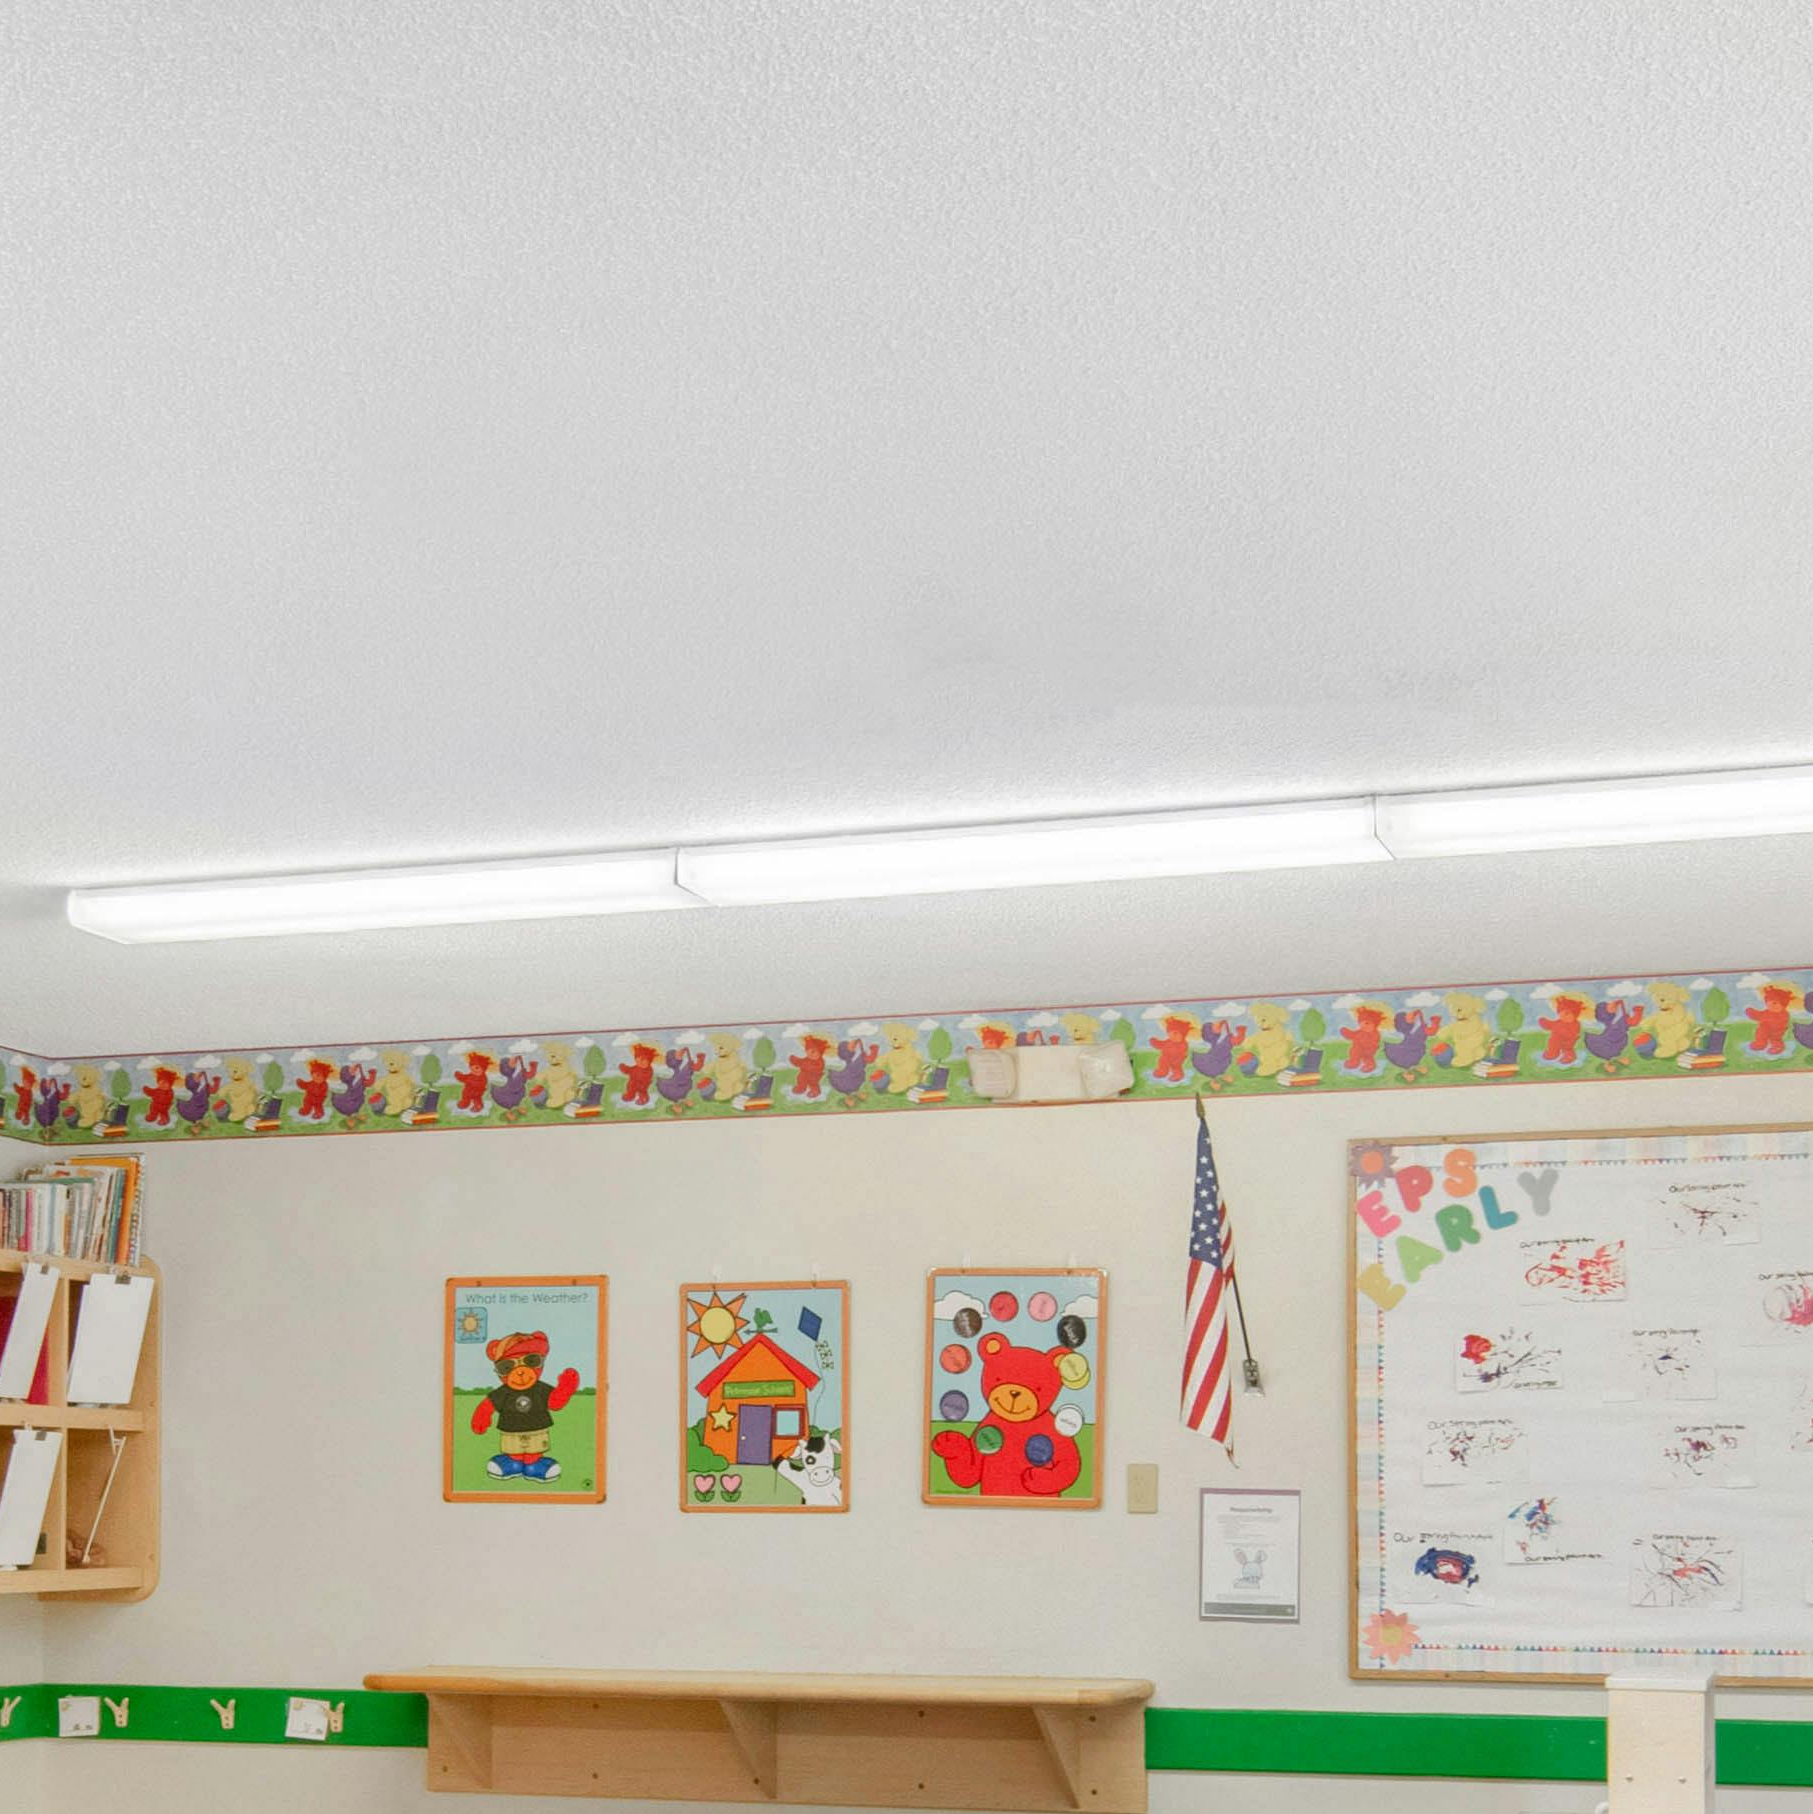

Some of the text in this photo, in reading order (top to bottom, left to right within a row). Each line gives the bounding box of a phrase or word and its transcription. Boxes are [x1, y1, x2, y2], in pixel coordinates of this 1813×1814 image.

[466, 1292, 589, 1305] What is the Weather?
